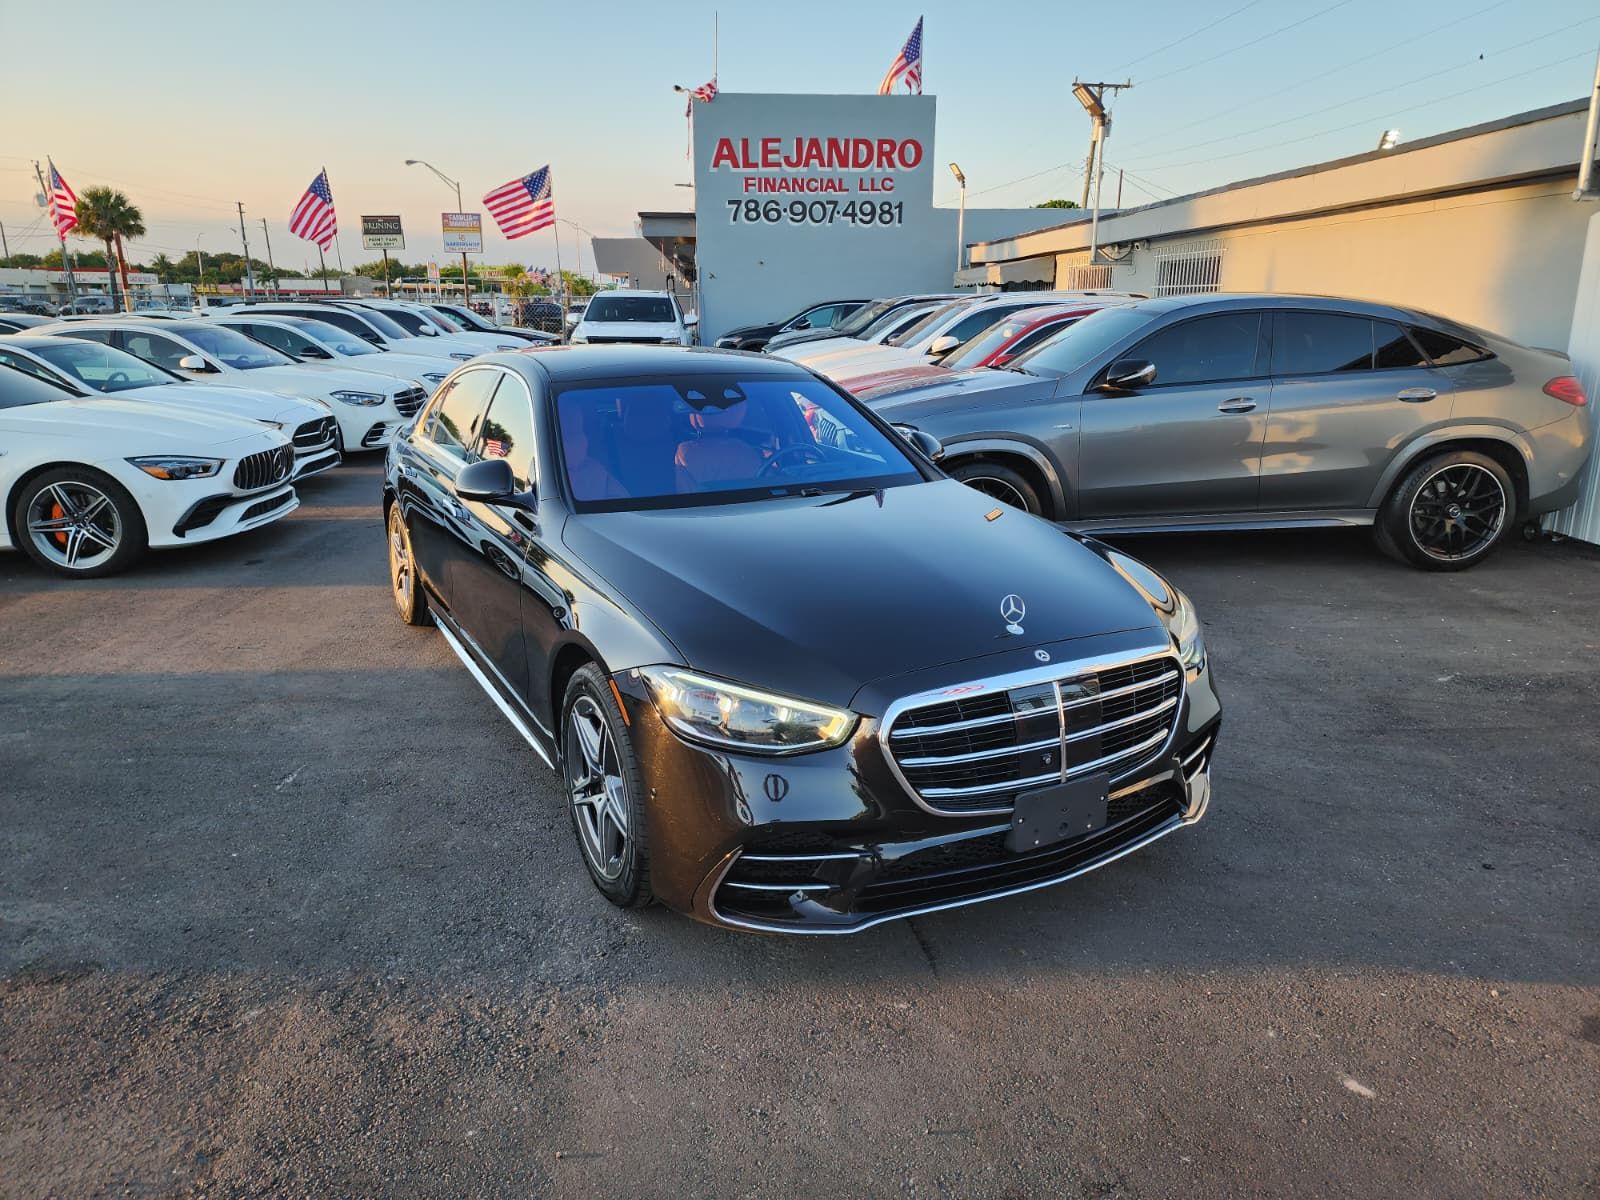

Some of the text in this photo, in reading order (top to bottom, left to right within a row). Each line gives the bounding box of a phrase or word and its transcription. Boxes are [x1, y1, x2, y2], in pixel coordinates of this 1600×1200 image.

[711, 137, 923, 169] ALEJANDRO
[743, 176, 895, 193] FINANCIAL LLC
